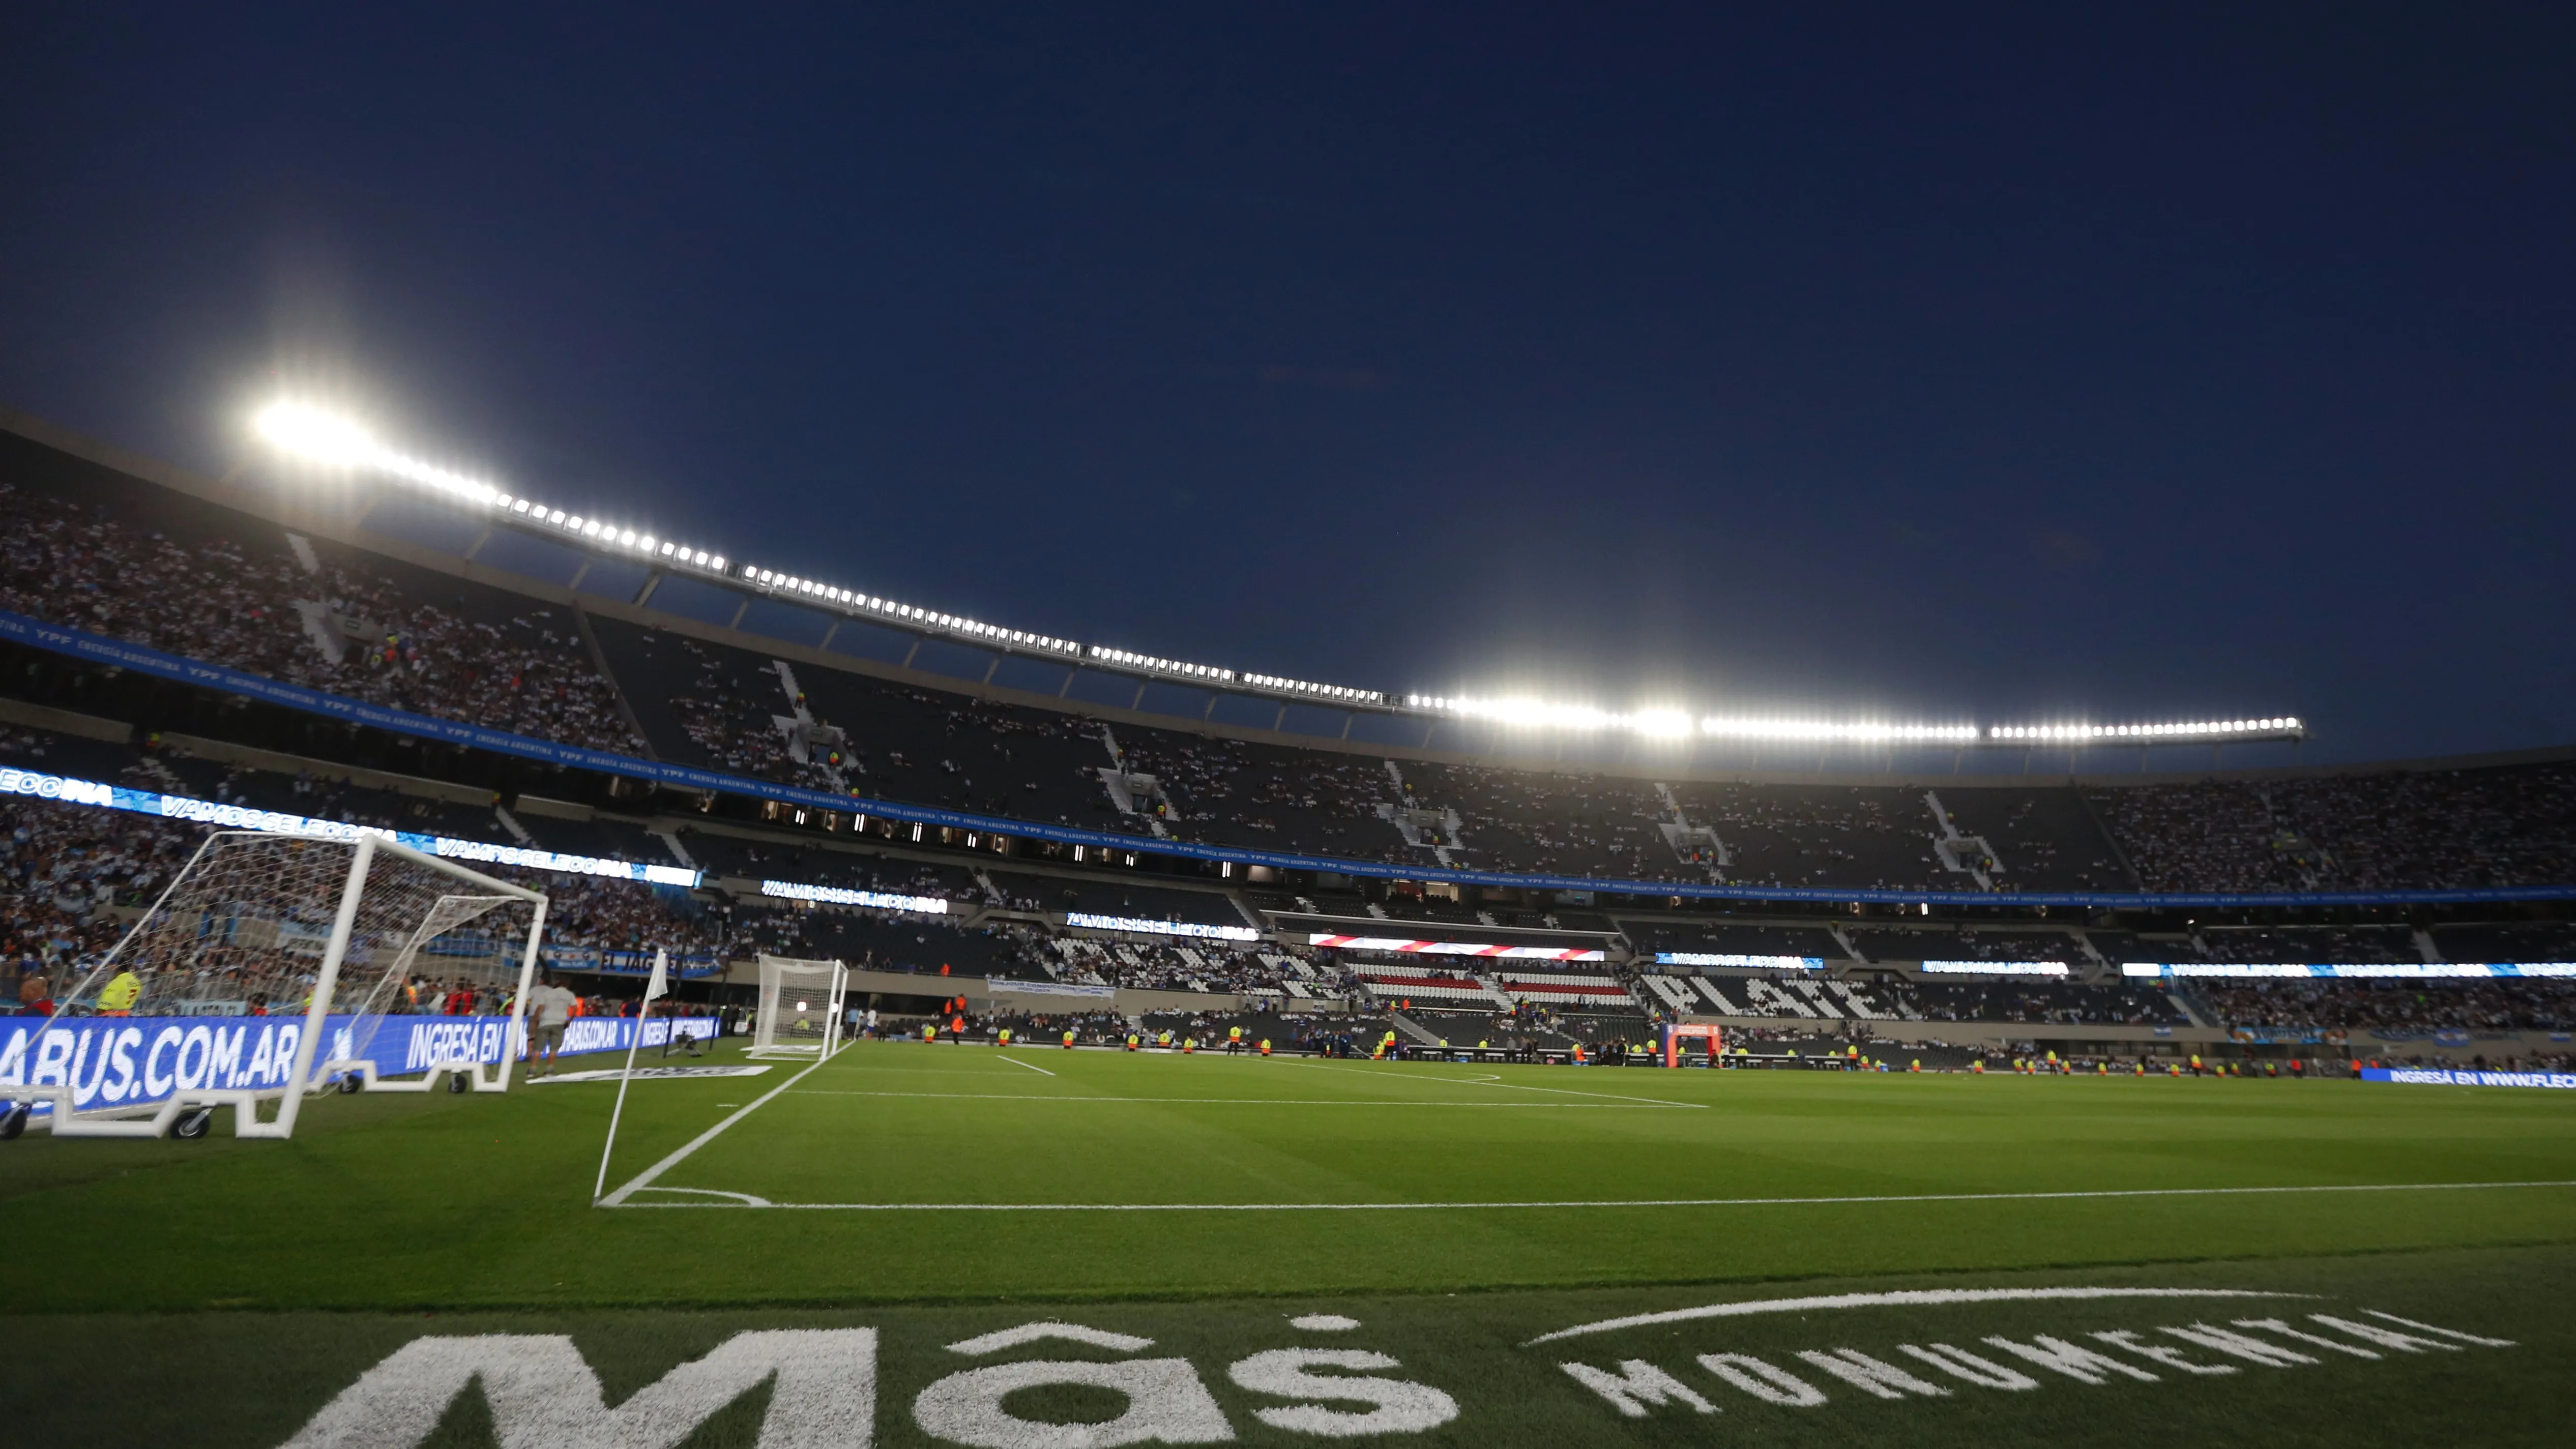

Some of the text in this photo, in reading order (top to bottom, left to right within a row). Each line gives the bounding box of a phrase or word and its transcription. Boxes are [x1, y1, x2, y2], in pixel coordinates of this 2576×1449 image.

[36, 629, 72, 644] YPF
[188, 667, 221, 680] YPF
[324, 700, 352, 712] YPF
[446, 727, 472, 738] YPF
[559, 750, 583, 761] YPF
[662, 768, 685, 778] YPF
[760, 785, 782, 794] YPF
[854, 802, 874, 810] YPF
[941, 814, 960, 822] YPF
[1023, 825, 1042, 834] YPF
[600, 950, 616, 971] EL
[622, 952, 680, 974] JAGE
[405, 1016, 483, 1069] INGRESÁ
[479, 1023, 505, 1062] EN
[2390, 1070, 2454, 1085] INGRESÁ
[2454, 1072, 2478, 1086] EN
[1559, 1308, 2520, 1417] MONUMENTAL
